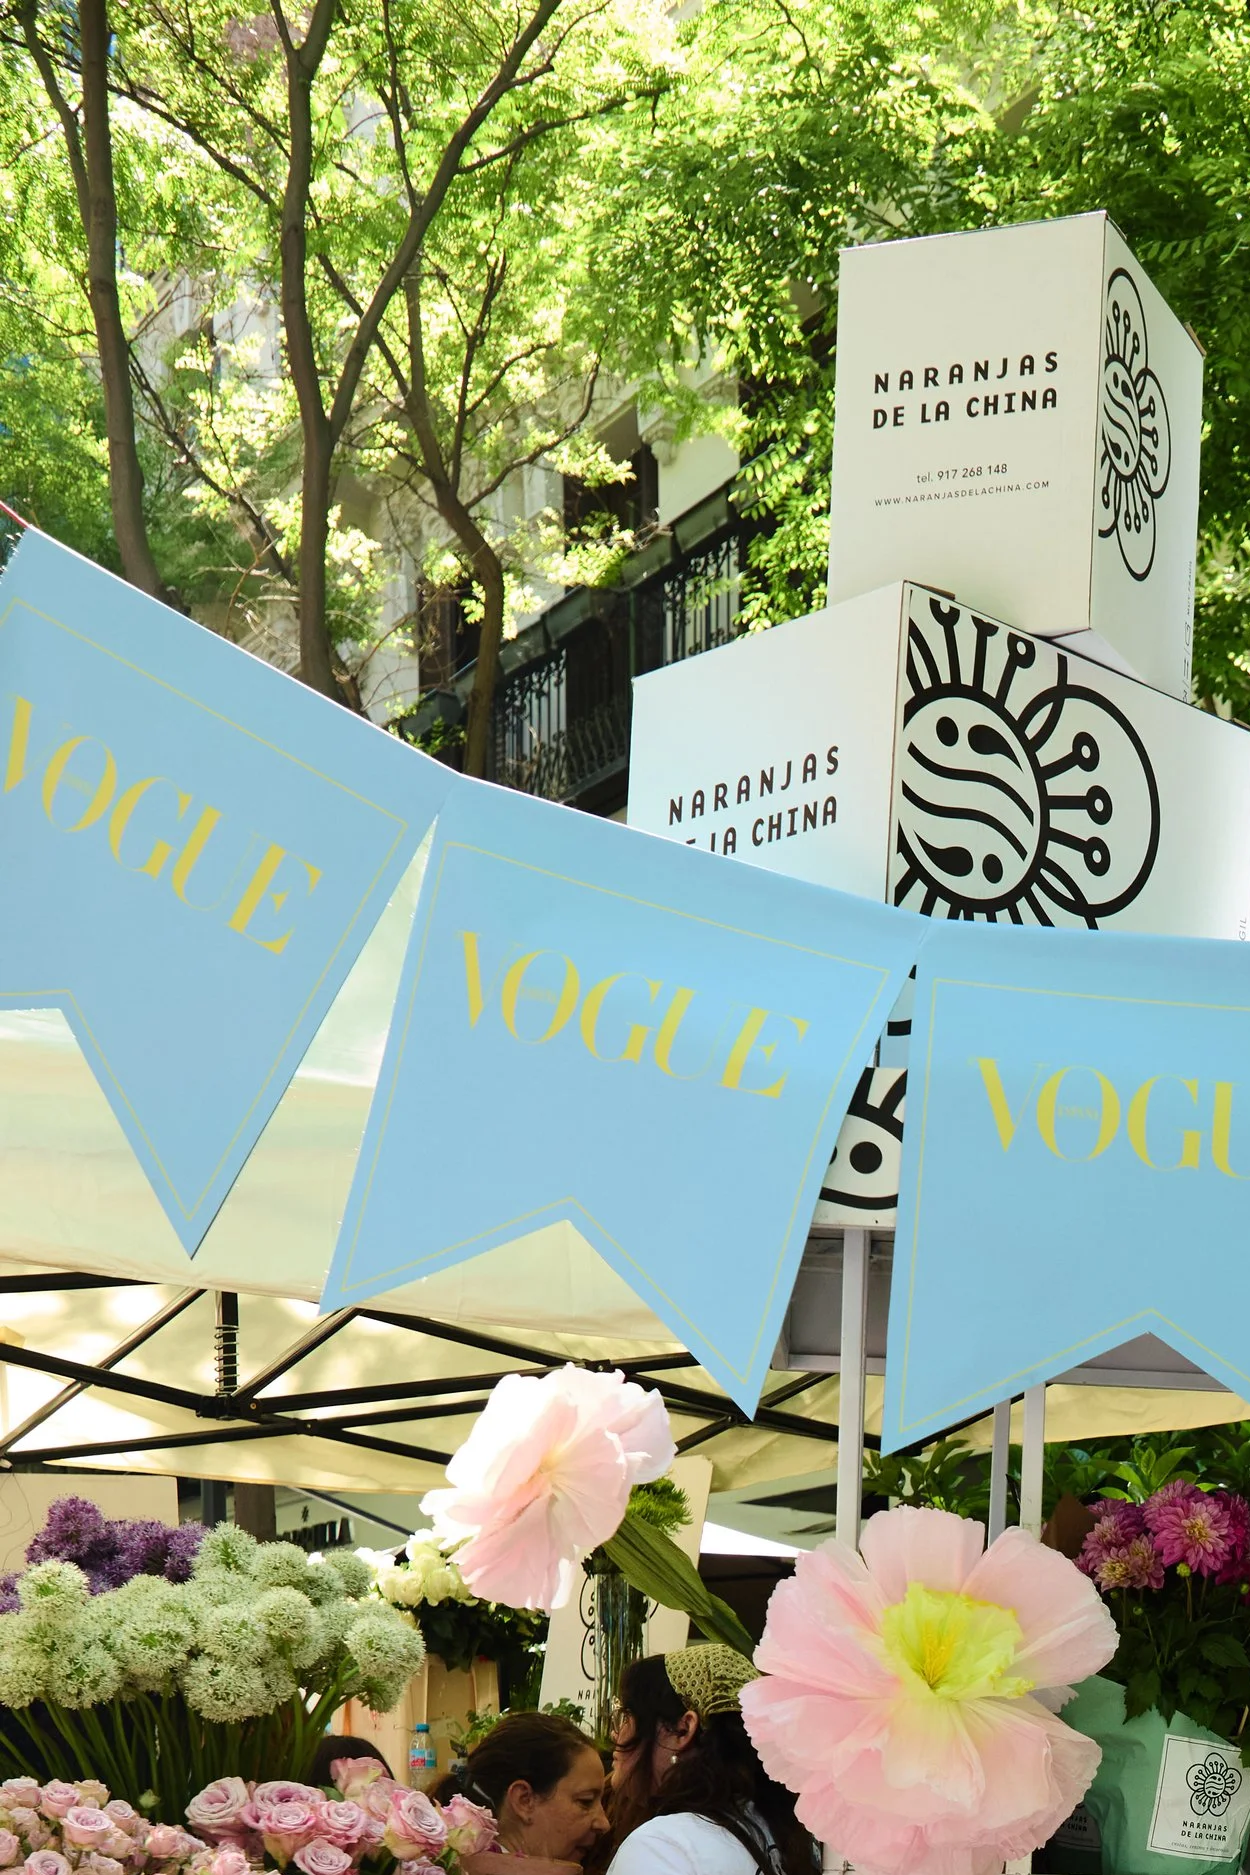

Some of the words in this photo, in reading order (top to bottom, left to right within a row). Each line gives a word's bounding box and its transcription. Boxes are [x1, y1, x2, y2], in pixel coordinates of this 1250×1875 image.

[874, 351, 1058, 394] NARANJAS
[872, 406, 905, 429] DE
[920, 400, 950, 423] LA
[966, 387, 1057, 418] CHINA
[874, 480, 1050, 507] WWW.NARANJASDELACHINA.COM
[916, 471, 933, 483] tel.
[937, 469, 958, 481] 917
[962, 466, 983, 479] 268
[987, 463, 1008, 475] 148
[669, 745, 839, 826] NARANJAS
[0, 694, 324, 957] VOGUE
[752, 796, 837, 847] CHINA
[453, 929, 811, 1099] VOGUE
[1181, 1830, 1192, 1838] DE
[1195, 1831, 1203, 1839] LA
[1205, 1833, 1227, 1842] CHINA
[1182, 1820, 1228, 1832] NARANJAS
